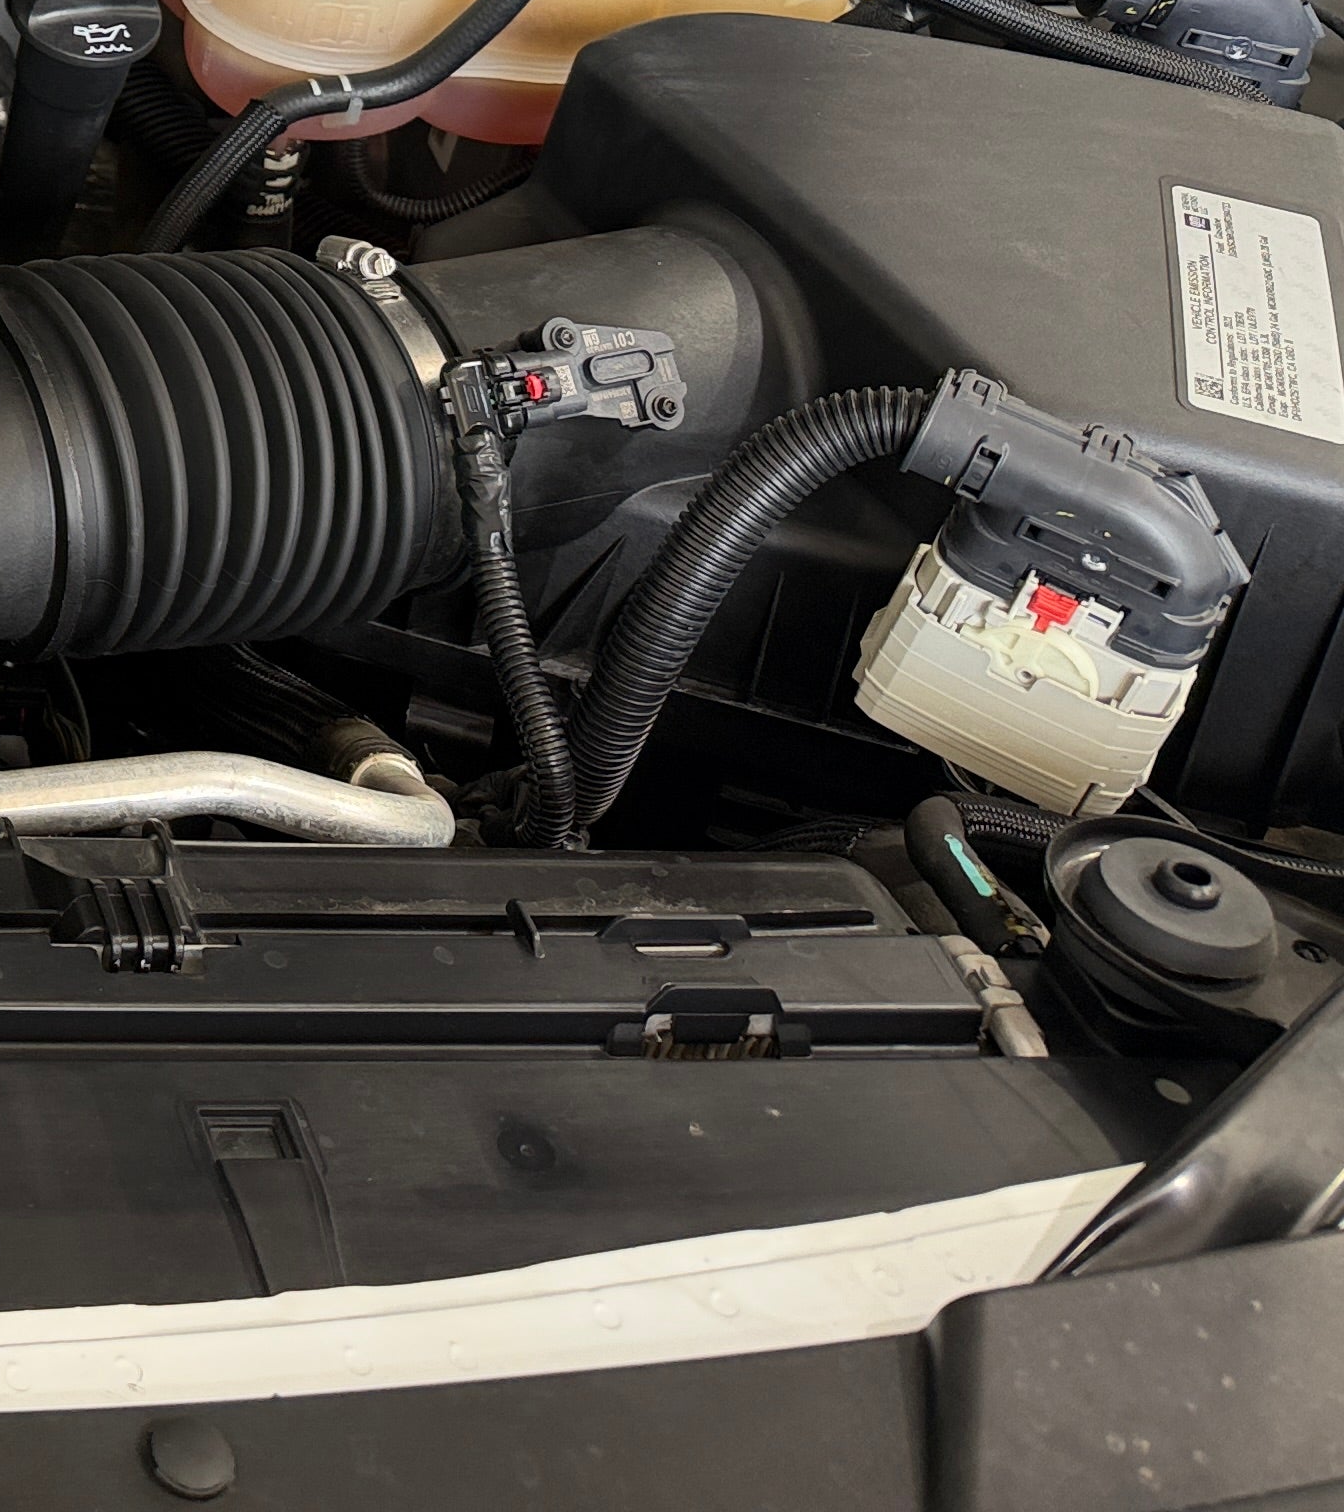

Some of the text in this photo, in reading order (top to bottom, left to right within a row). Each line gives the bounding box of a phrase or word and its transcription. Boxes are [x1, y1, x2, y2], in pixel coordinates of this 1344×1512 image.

[1187, 259, 1202, 330] VEHICLE EMISSION
[1199, 253, 1217, 345] CONTROL INFORMATION
